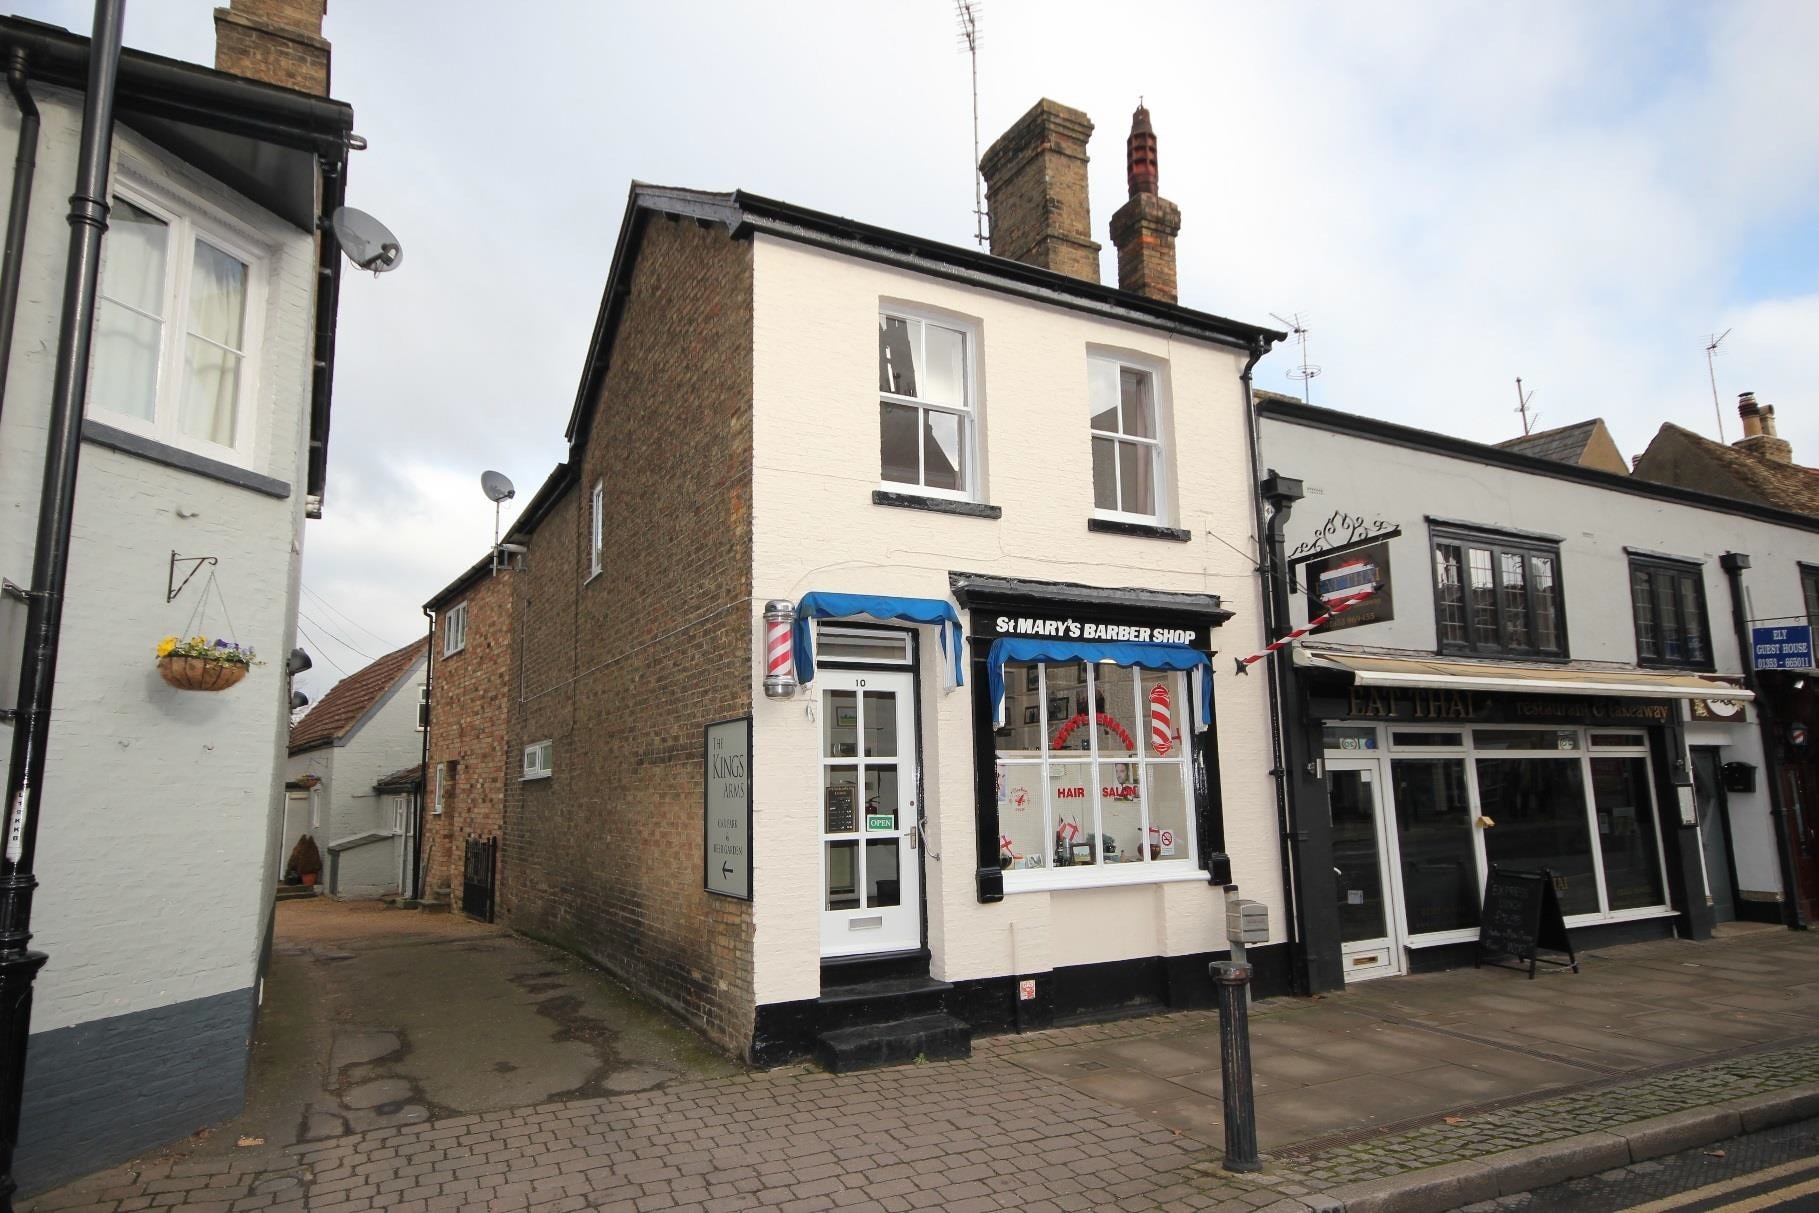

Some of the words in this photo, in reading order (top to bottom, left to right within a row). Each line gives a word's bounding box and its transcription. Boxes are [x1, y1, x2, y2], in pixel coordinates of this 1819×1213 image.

[996, 616, 1015, 633] St
[1017, 617, 1081, 638] MARY'S
[1083, 623, 1150, 643] BARBER
[1152, 628, 1196, 645] SHOP
[1773, 630, 1787, 640] ELY
[1756, 644, 1780, 655] GUEST
[1782, 643, 1808, 653] HOUSE
[855, 679, 866, 687] 10
[1347, 687, 1400, 717] EAT
[1408, 687, 1474, 718] THAI
[712, 737, 724, 751] THE
[712, 753, 744, 779] KINGS
[723, 782, 745, 799] ARMS
[1057, 787, 1085, 799] HAIR
[1102, 786, 1137, 797] SALON
[870, 819, 891, 827] OPEN
